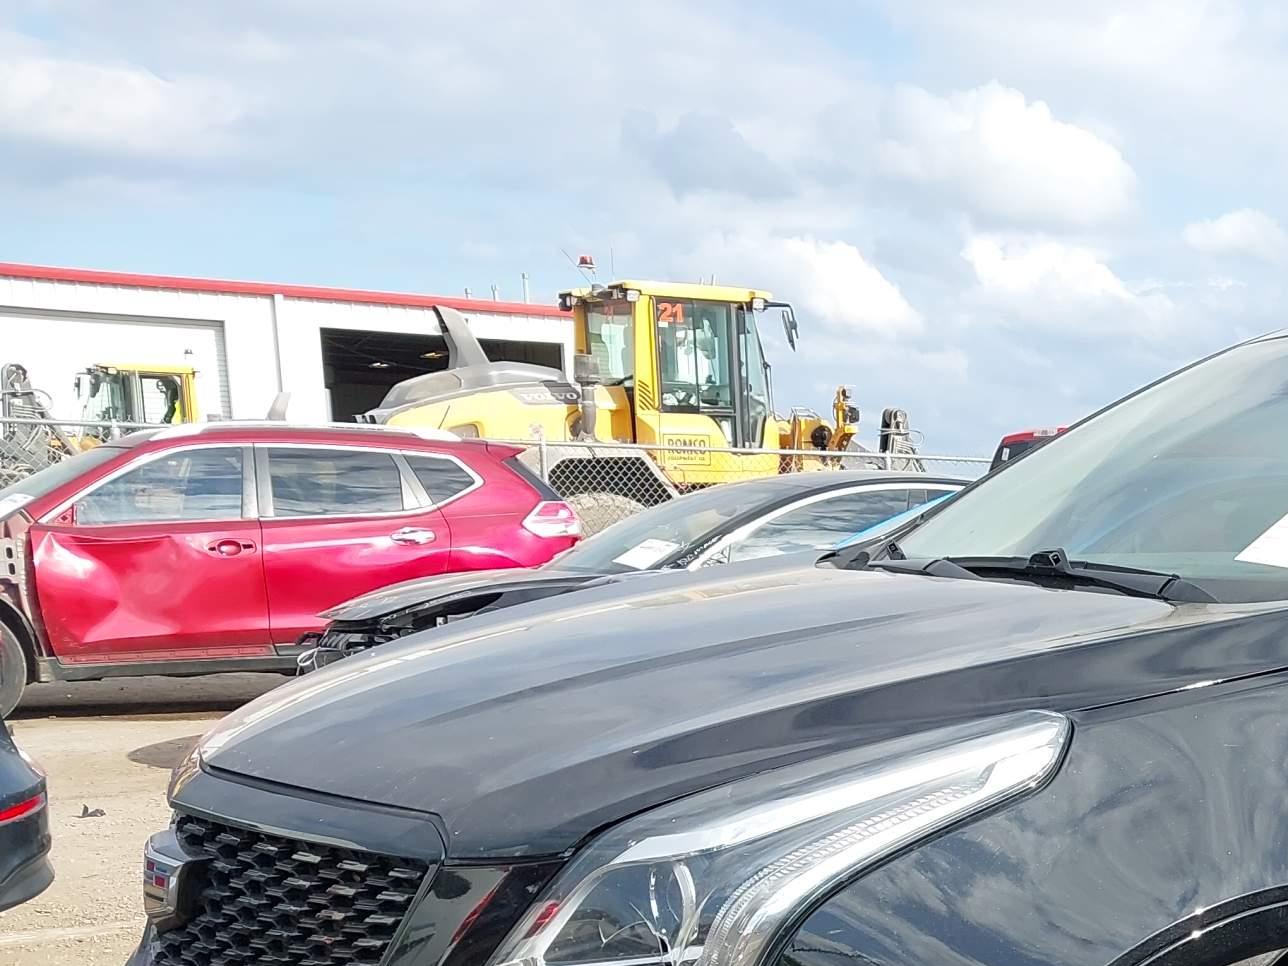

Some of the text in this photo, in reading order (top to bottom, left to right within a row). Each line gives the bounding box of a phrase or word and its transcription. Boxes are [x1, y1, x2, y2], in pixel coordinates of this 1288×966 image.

[657, 302, 684, 323] 21
[519, 392, 578, 401] VOLVO
[667, 438, 706, 455] ROMCO
